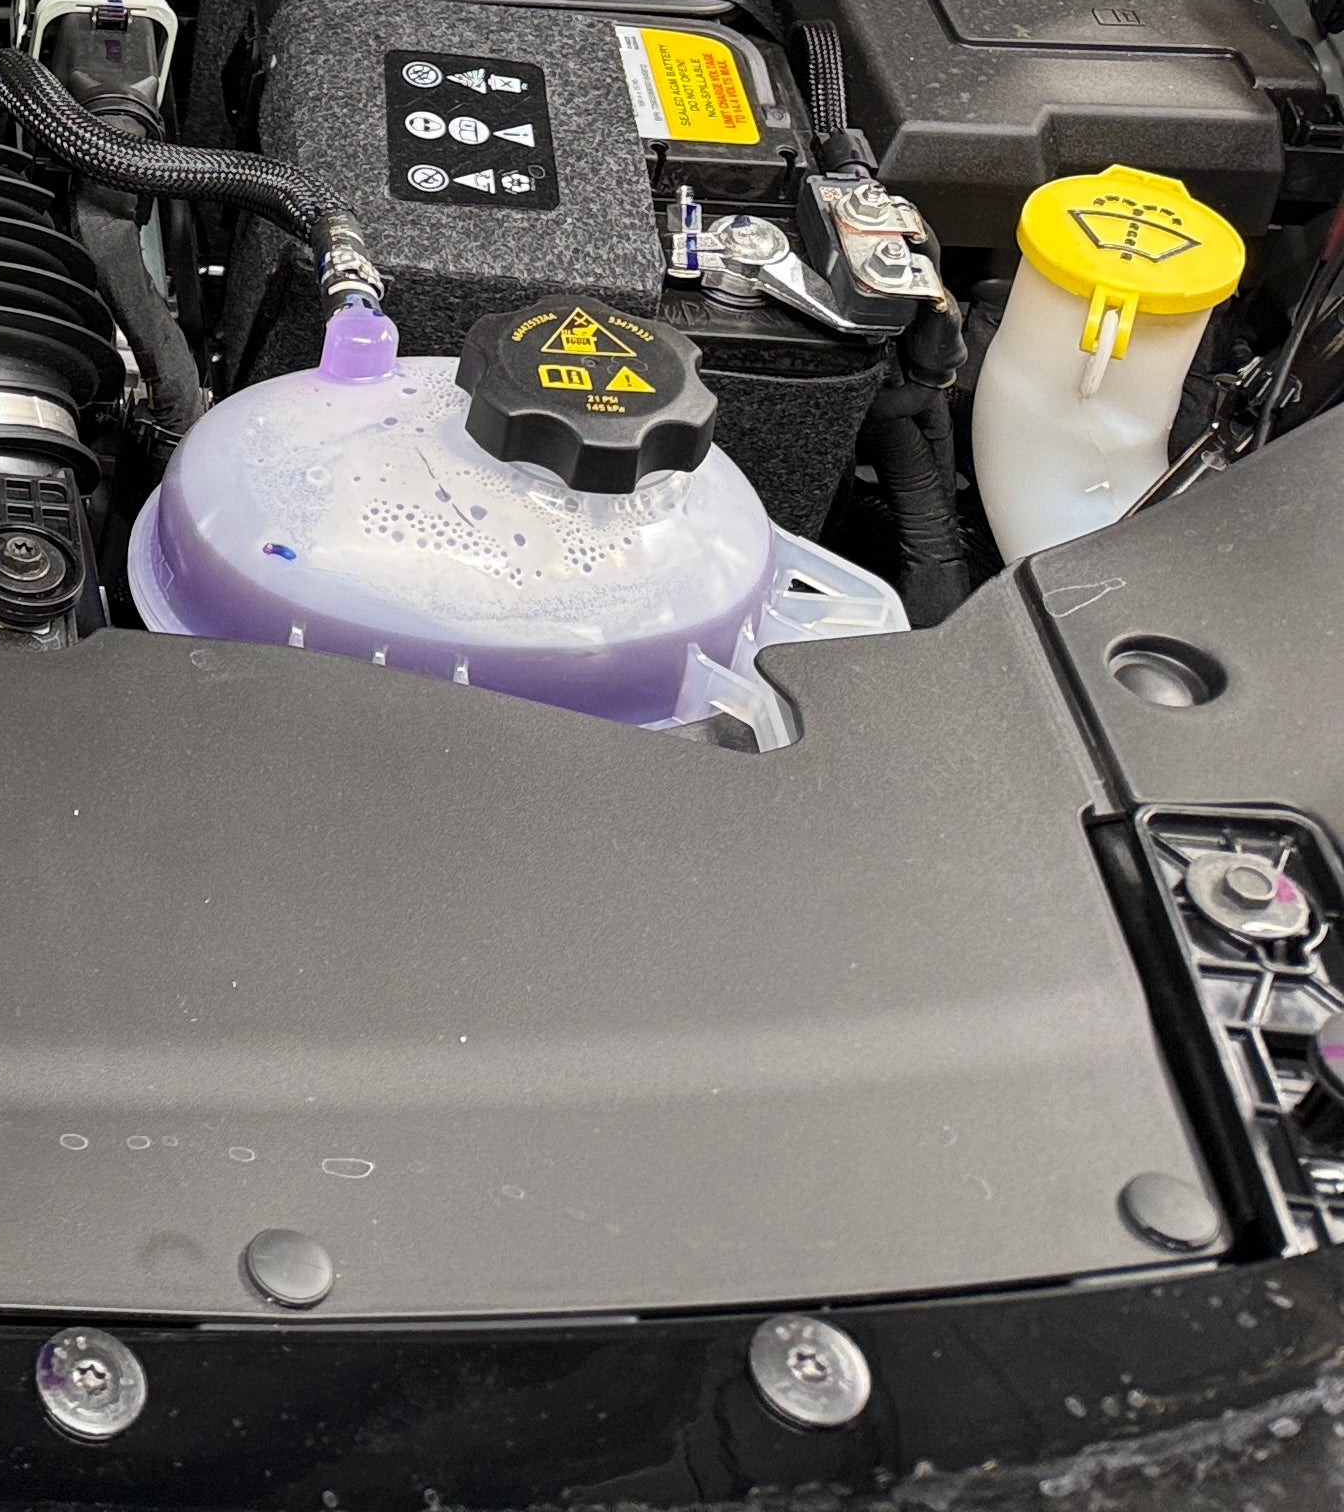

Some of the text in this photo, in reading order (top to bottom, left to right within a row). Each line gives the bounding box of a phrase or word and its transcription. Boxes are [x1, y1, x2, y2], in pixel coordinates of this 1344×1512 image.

[658, 44, 691, 126] SEALED AGM BATTERY
[683, 85, 697, 99] NOT
[687, 101, 700, 111] DO
[722, 111, 735, 128] LIMIT
[587, 395, 619, 404] 21 PSI
